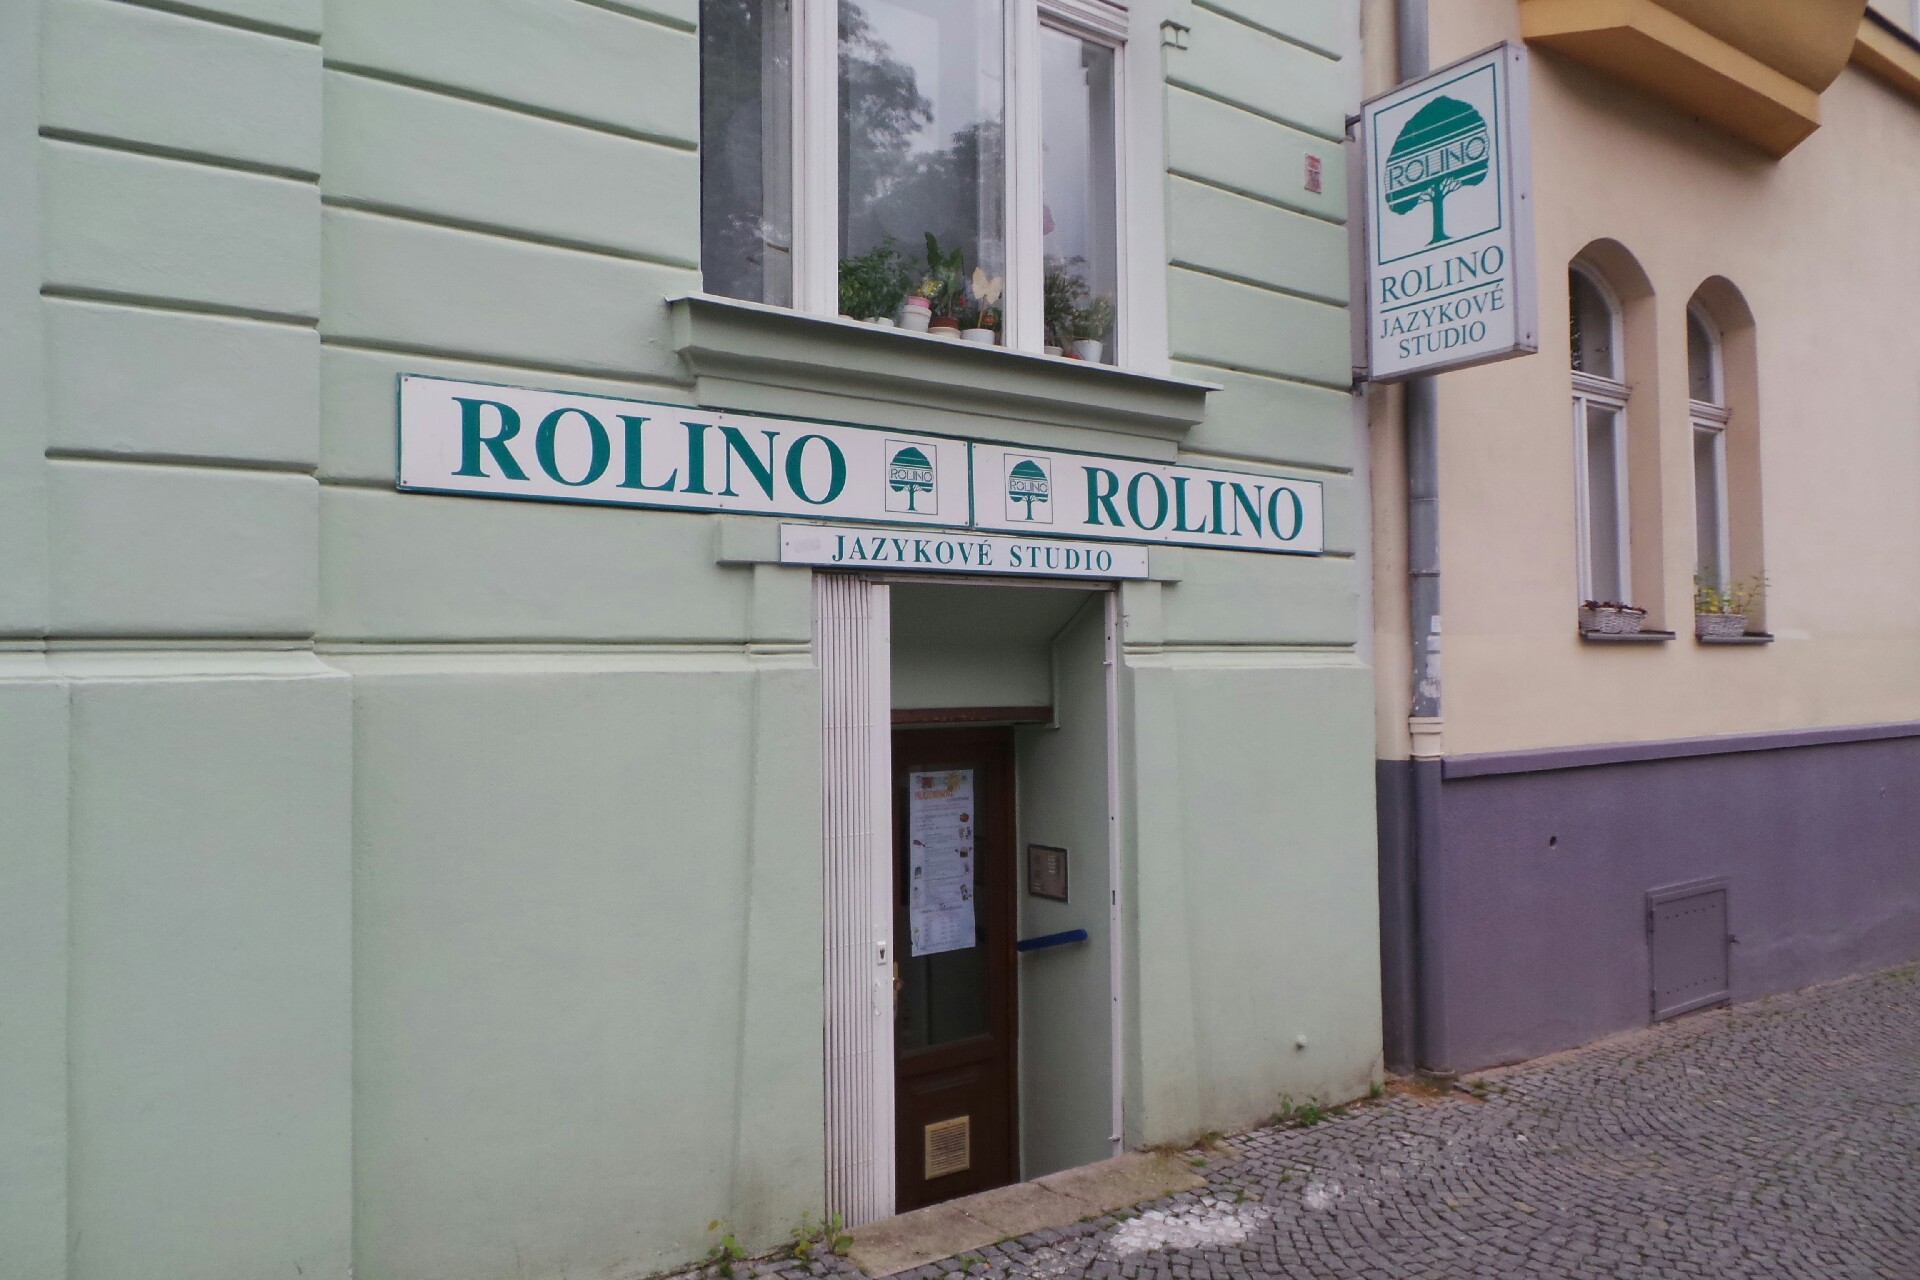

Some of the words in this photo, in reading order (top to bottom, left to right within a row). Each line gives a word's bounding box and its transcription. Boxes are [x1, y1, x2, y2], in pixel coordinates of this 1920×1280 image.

[1388, 136, 1486, 190] ROLINO
[1380, 245, 1504, 303] ROLINO
[1381, 284, 1504, 339] JAZYKOVÉ
[1399, 320, 1486, 359] STUDIO
[451, 397, 846, 504] ROLINO
[890, 468, 933, 483] ROLINO
[1010, 479, 1048, 493] ROLINO
[1081, 466, 1304, 541] ROLINO
[832, 535, 993, 566] JAZYKOVÉ
[1010, 545, 1112, 572] STUDIO
